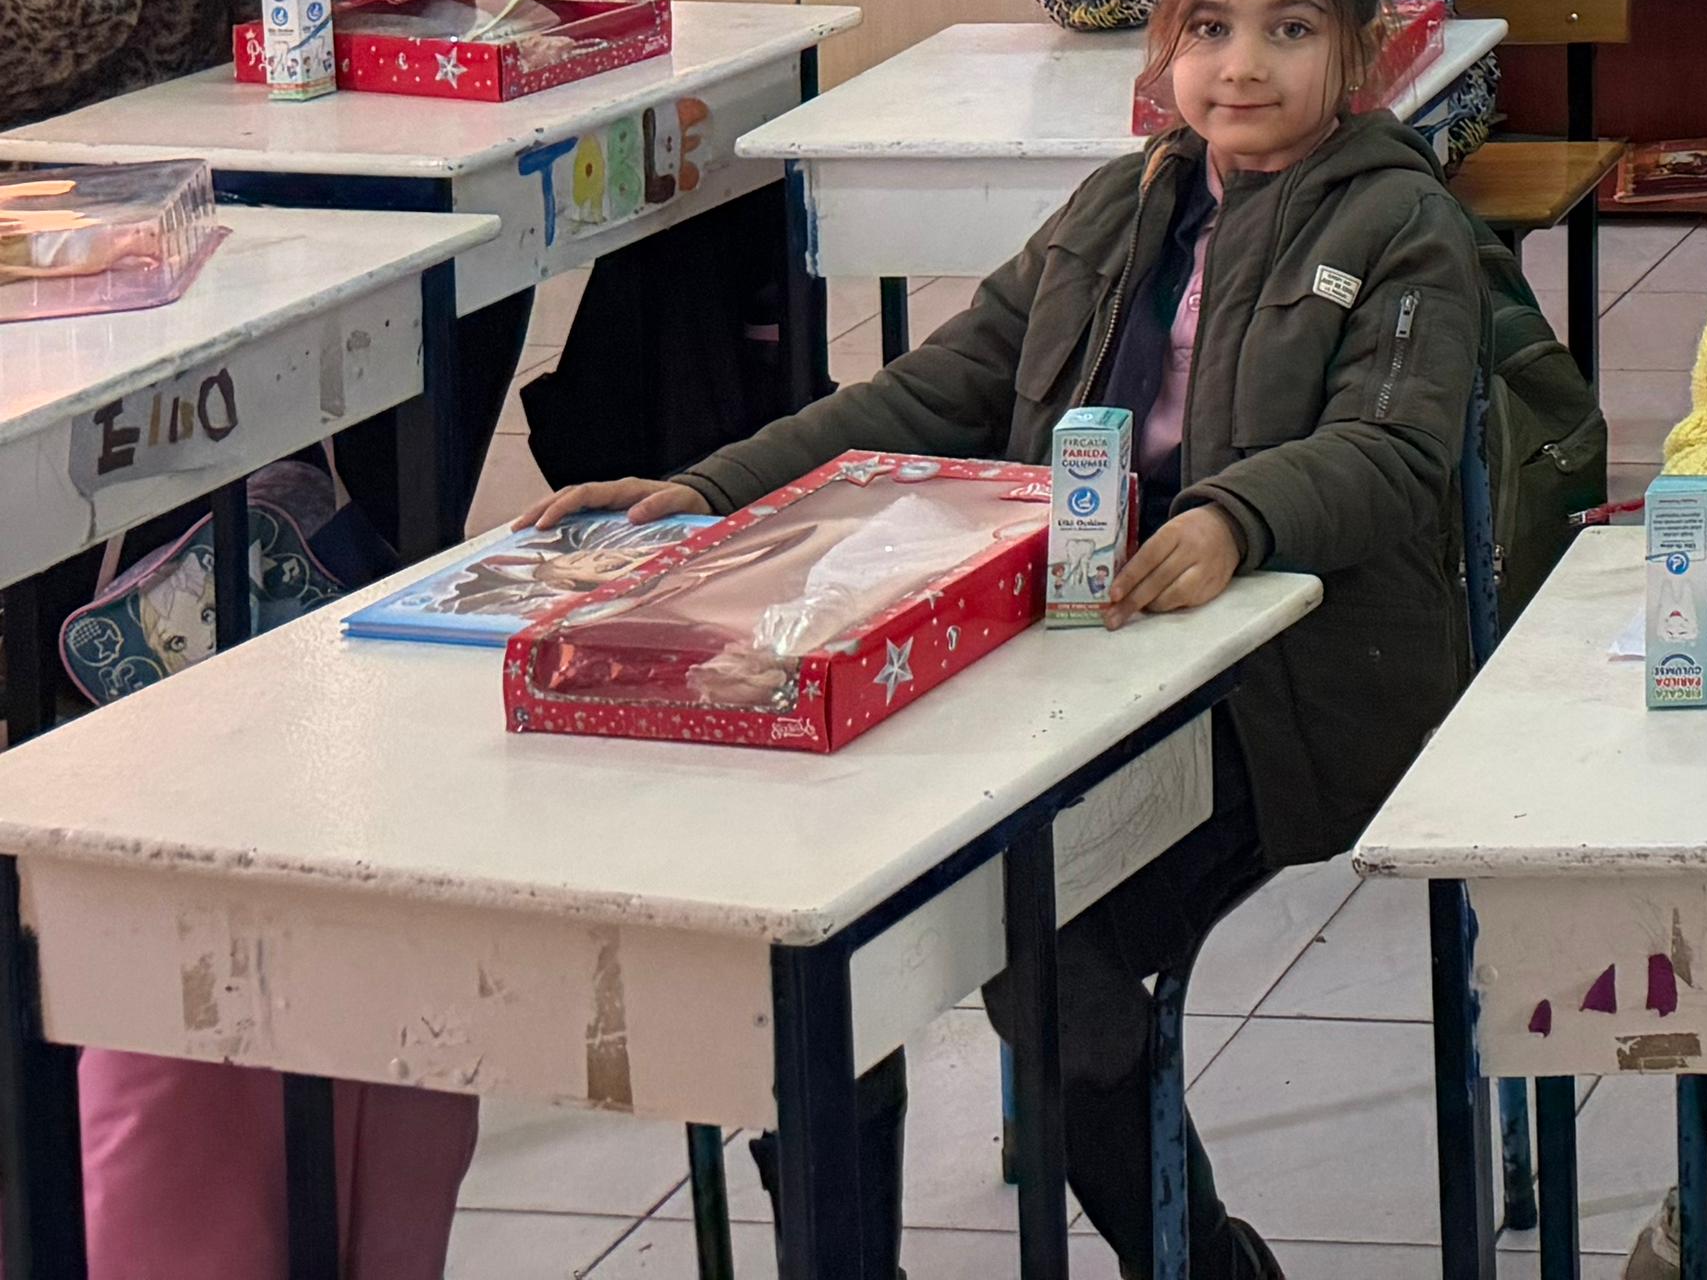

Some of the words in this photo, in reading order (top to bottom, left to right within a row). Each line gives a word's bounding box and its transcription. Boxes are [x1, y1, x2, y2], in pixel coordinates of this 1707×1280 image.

[518, 96, 711, 248] TABLE
[1062, 448, 1109, 458] PARILDA
[1655, 677, 1703, 687] PARILDA
